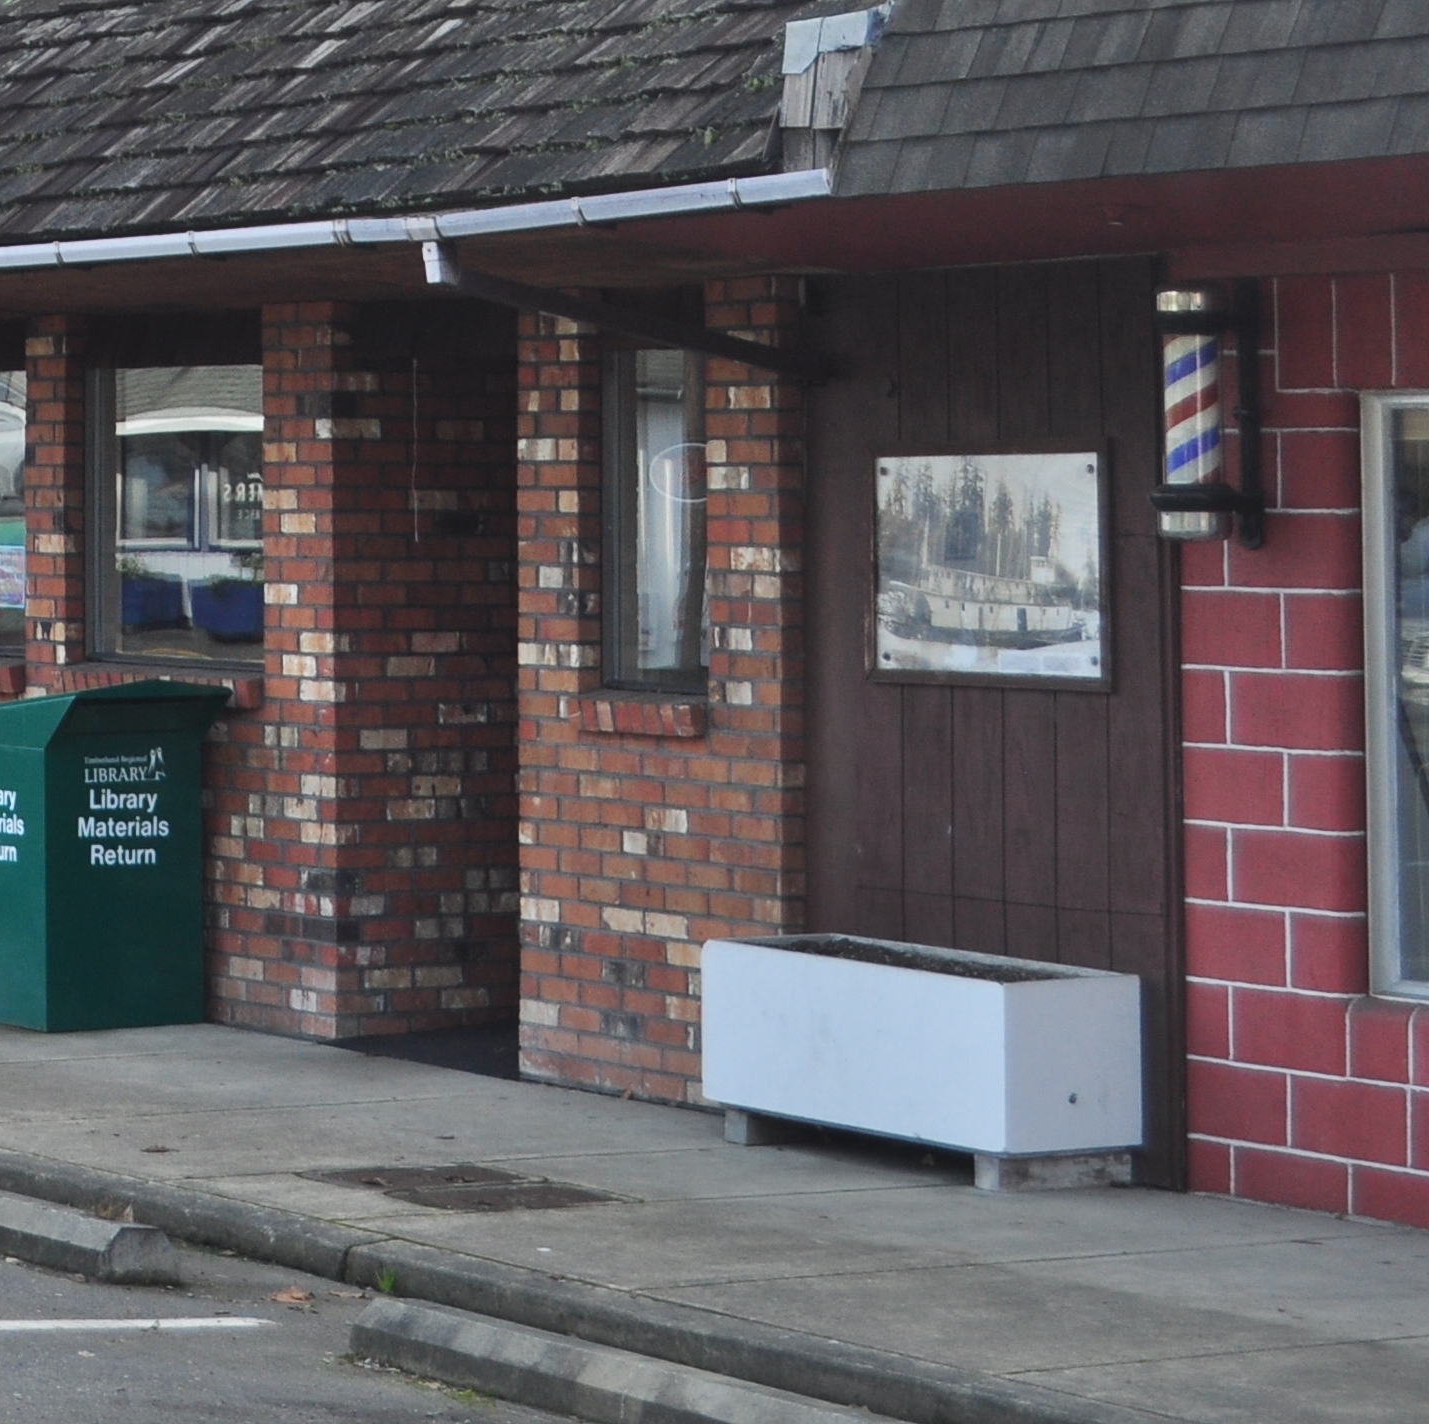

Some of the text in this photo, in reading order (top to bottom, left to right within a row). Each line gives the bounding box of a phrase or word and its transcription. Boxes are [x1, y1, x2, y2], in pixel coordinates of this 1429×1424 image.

[84, 766, 148, 784] LIBRARY
[89, 787, 158, 814] Library
[77, 815, 170, 838] Materials
[90, 844, 157, 866] Return
